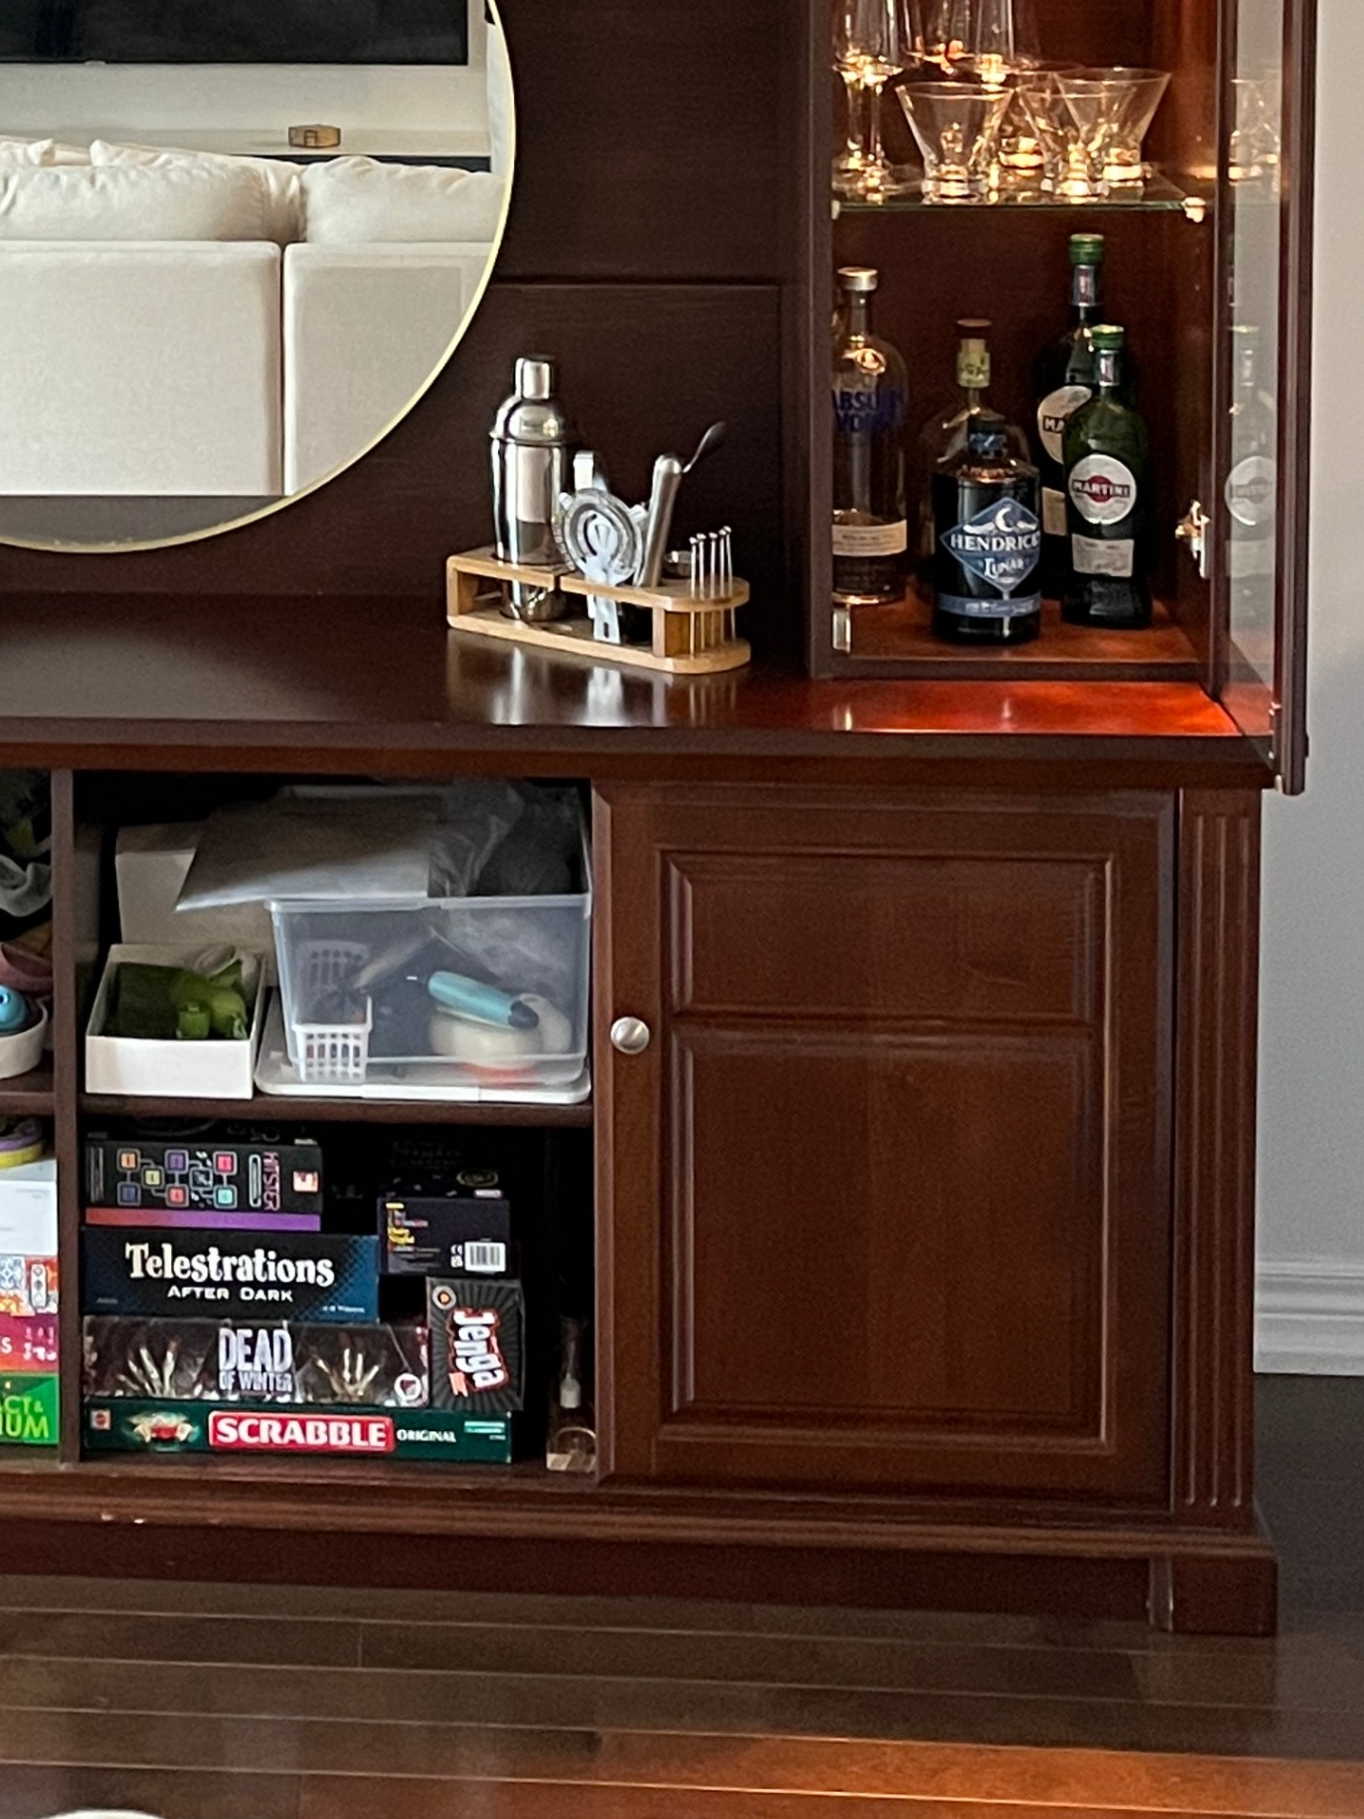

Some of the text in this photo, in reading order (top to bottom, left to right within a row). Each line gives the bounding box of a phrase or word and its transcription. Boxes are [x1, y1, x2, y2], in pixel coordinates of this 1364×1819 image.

[1073, 481, 1130, 497] MARTINI
[125, 1242, 335, 1288] Telestrations
[167, 1285, 294, 1303] AFTER DARK
[219, 1326, 293, 1373] DEAD
[453, 1309, 506, 1389] Jenga
[219, 1370, 293, 1393] OF WINTER
[216, 1418, 387, 1448] SCRABBLE
[396, 1428, 457, 1443] ORIGINAL
